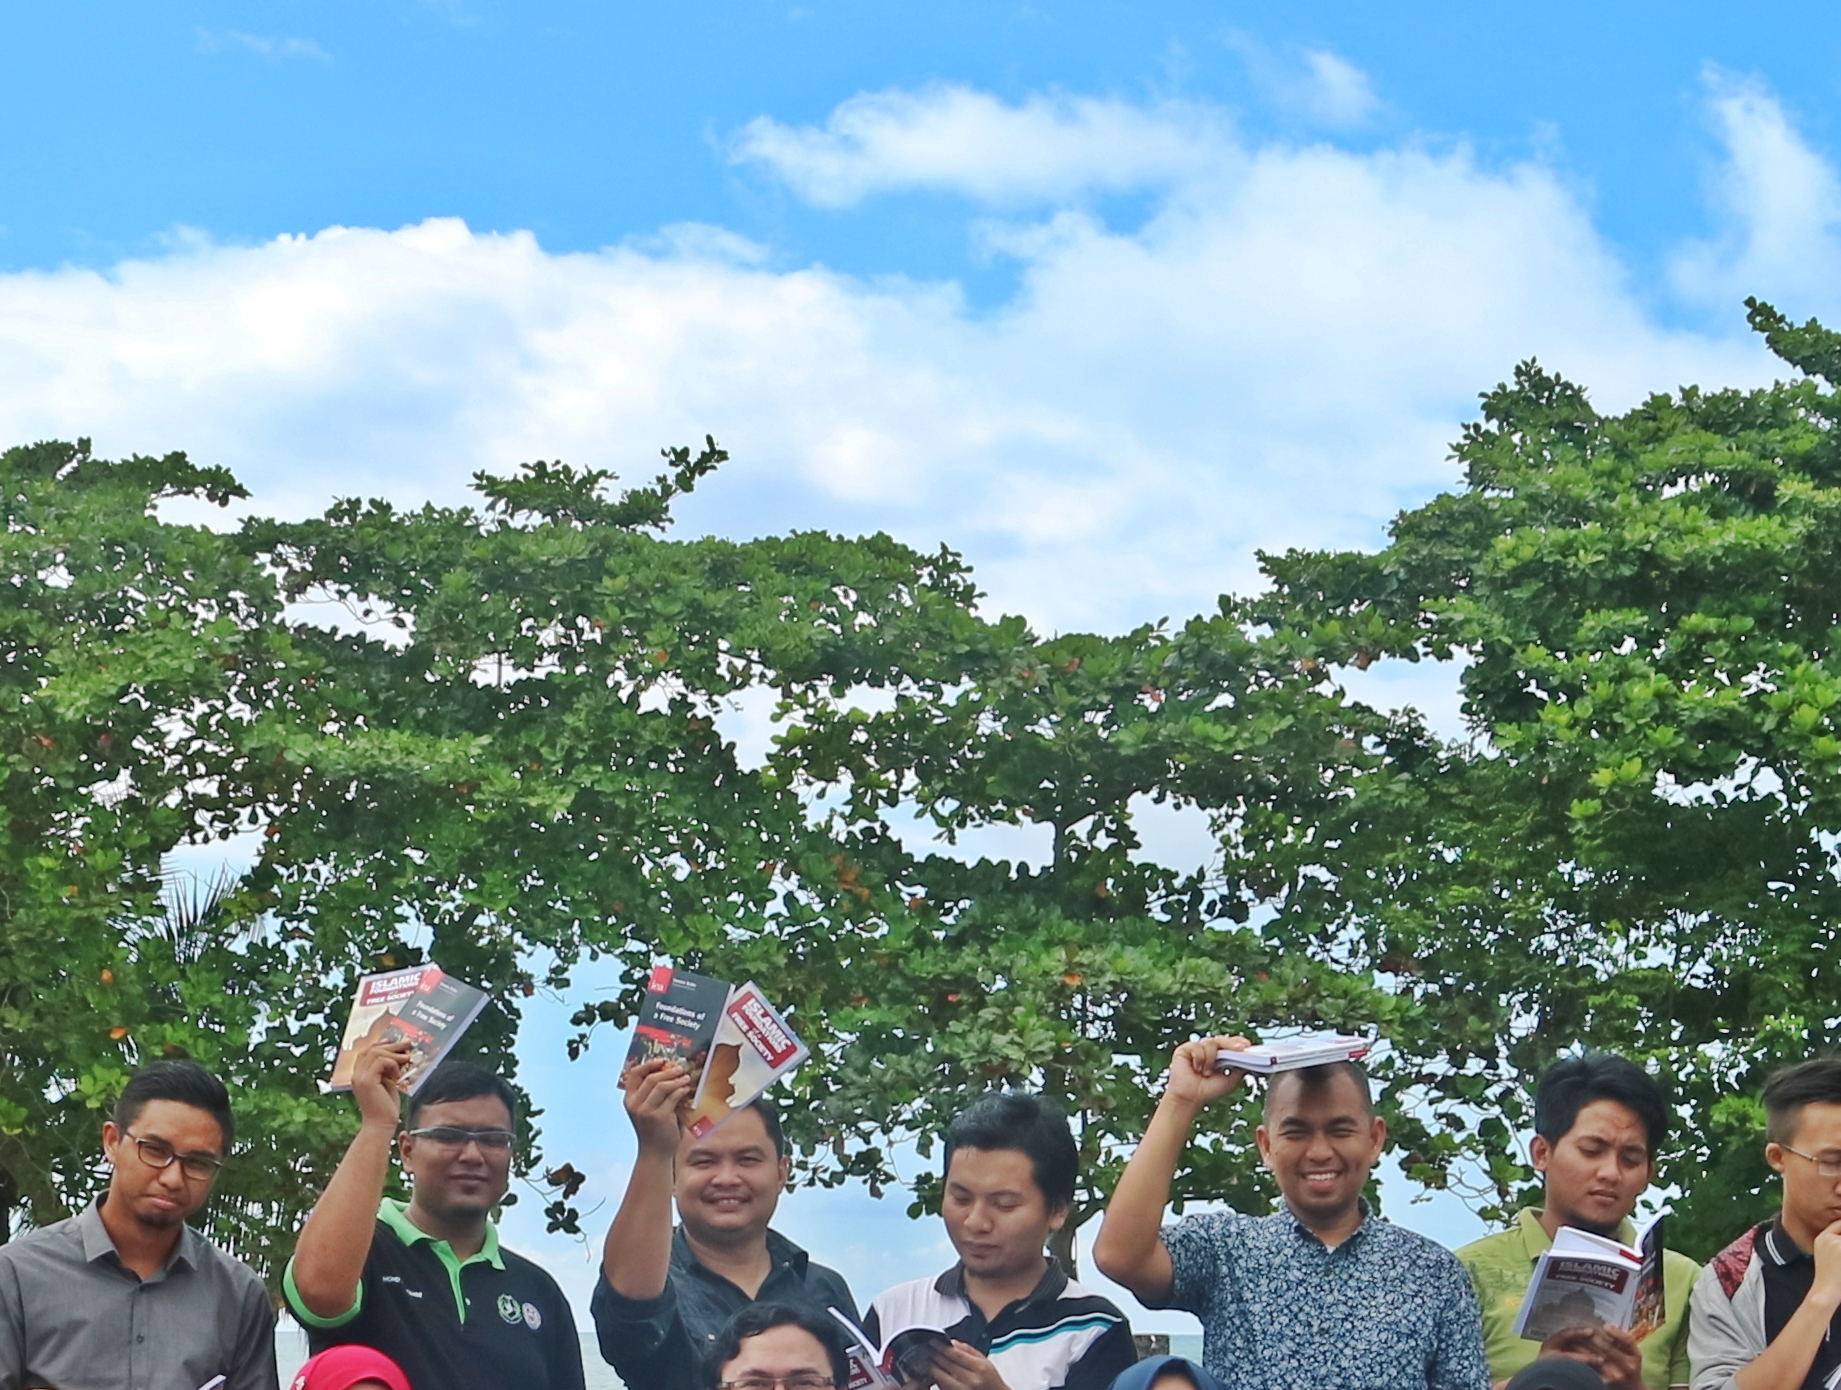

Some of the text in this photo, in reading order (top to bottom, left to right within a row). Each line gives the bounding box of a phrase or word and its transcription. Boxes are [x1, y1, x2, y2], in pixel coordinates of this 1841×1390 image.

[370, 971, 422, 989] ISLAMIC
[366, 996, 386, 1005] FREE
[416, 1000, 448, 1019] Foundations
[416, 1010, 429, 1021] Free
[428, 1016, 448, 1031] Society
[655, 1001, 706, 1021] Foundations of
[660, 1012, 675, 1024] Free
[675, 1016, 702, 1032] Society
[741, 1004, 782, 1054] FOUNDATIONS
[746, 998, 792, 1052] ISLAMIC
[731, 1012, 775, 1062] FREE SOCIETY
[1560, 1260, 1621, 1276] ISLAMIC
